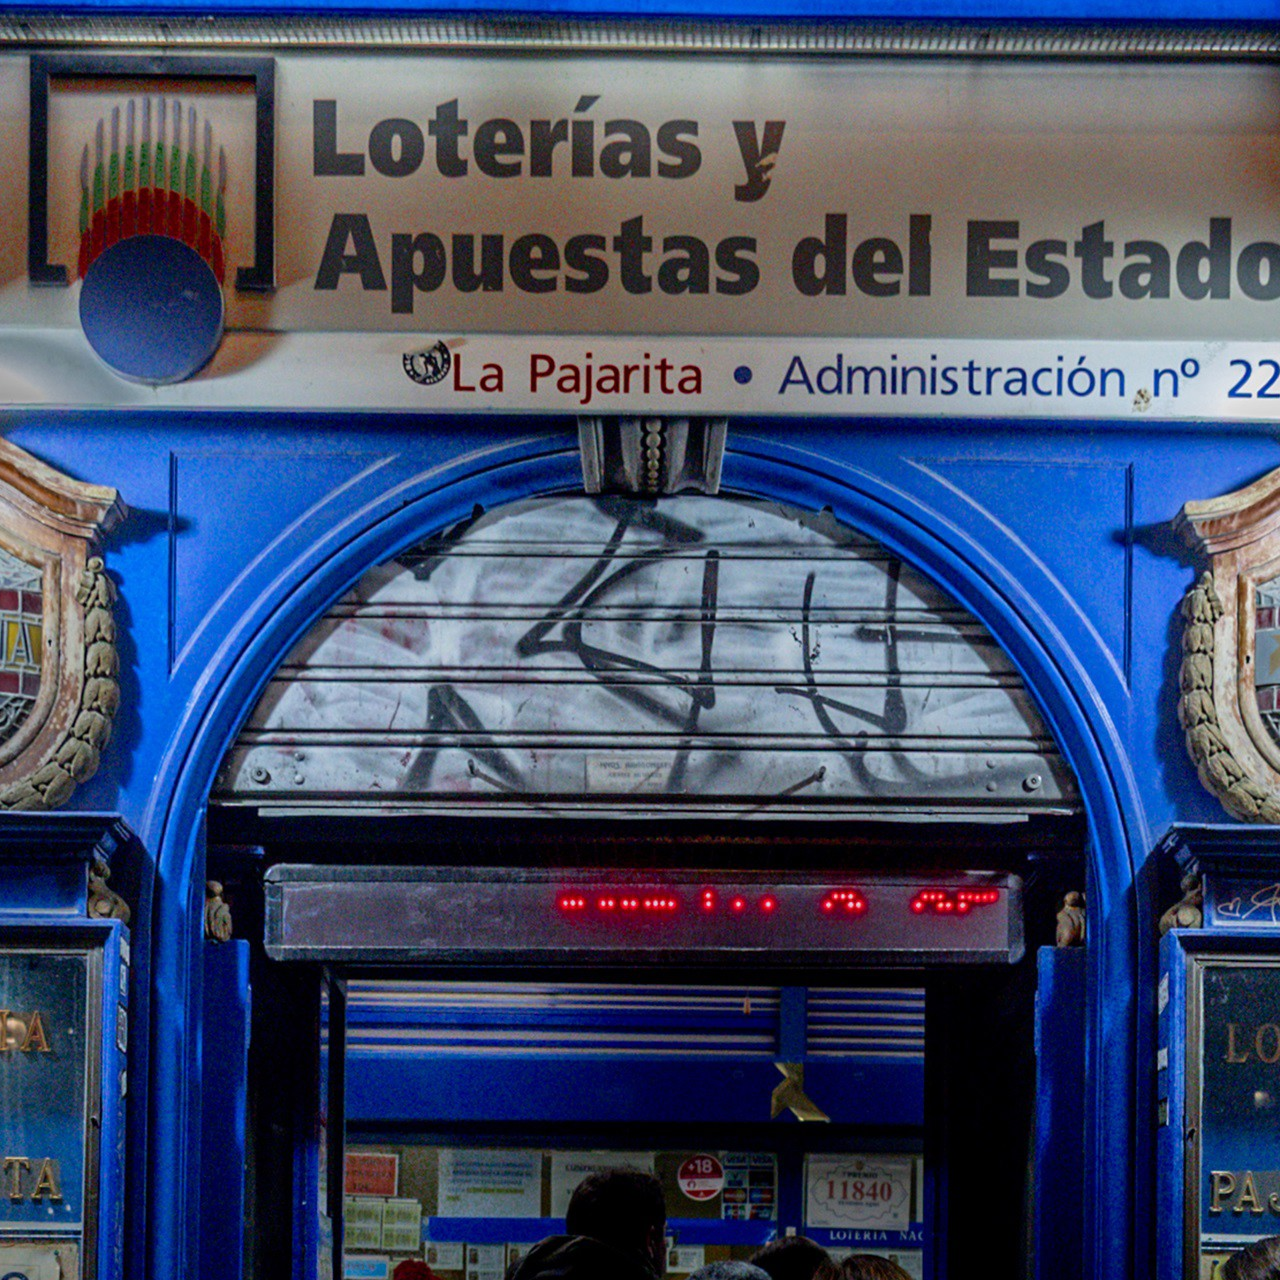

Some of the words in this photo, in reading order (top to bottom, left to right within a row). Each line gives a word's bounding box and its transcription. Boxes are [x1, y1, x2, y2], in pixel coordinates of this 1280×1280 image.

[312, 95, 702, 179] Loterías
[732, 119, 786, 202] y
[314, 212, 762, 313] Apuestas
[792, 212, 932, 298] del
[453, 353, 505, 394] La
[530, 350, 703, 404] Pajarita
[779, 354, 1126, 401] Administración
[1152, 360, 1201, 400] nº
[828, 1180, 892, 1201] 11840
